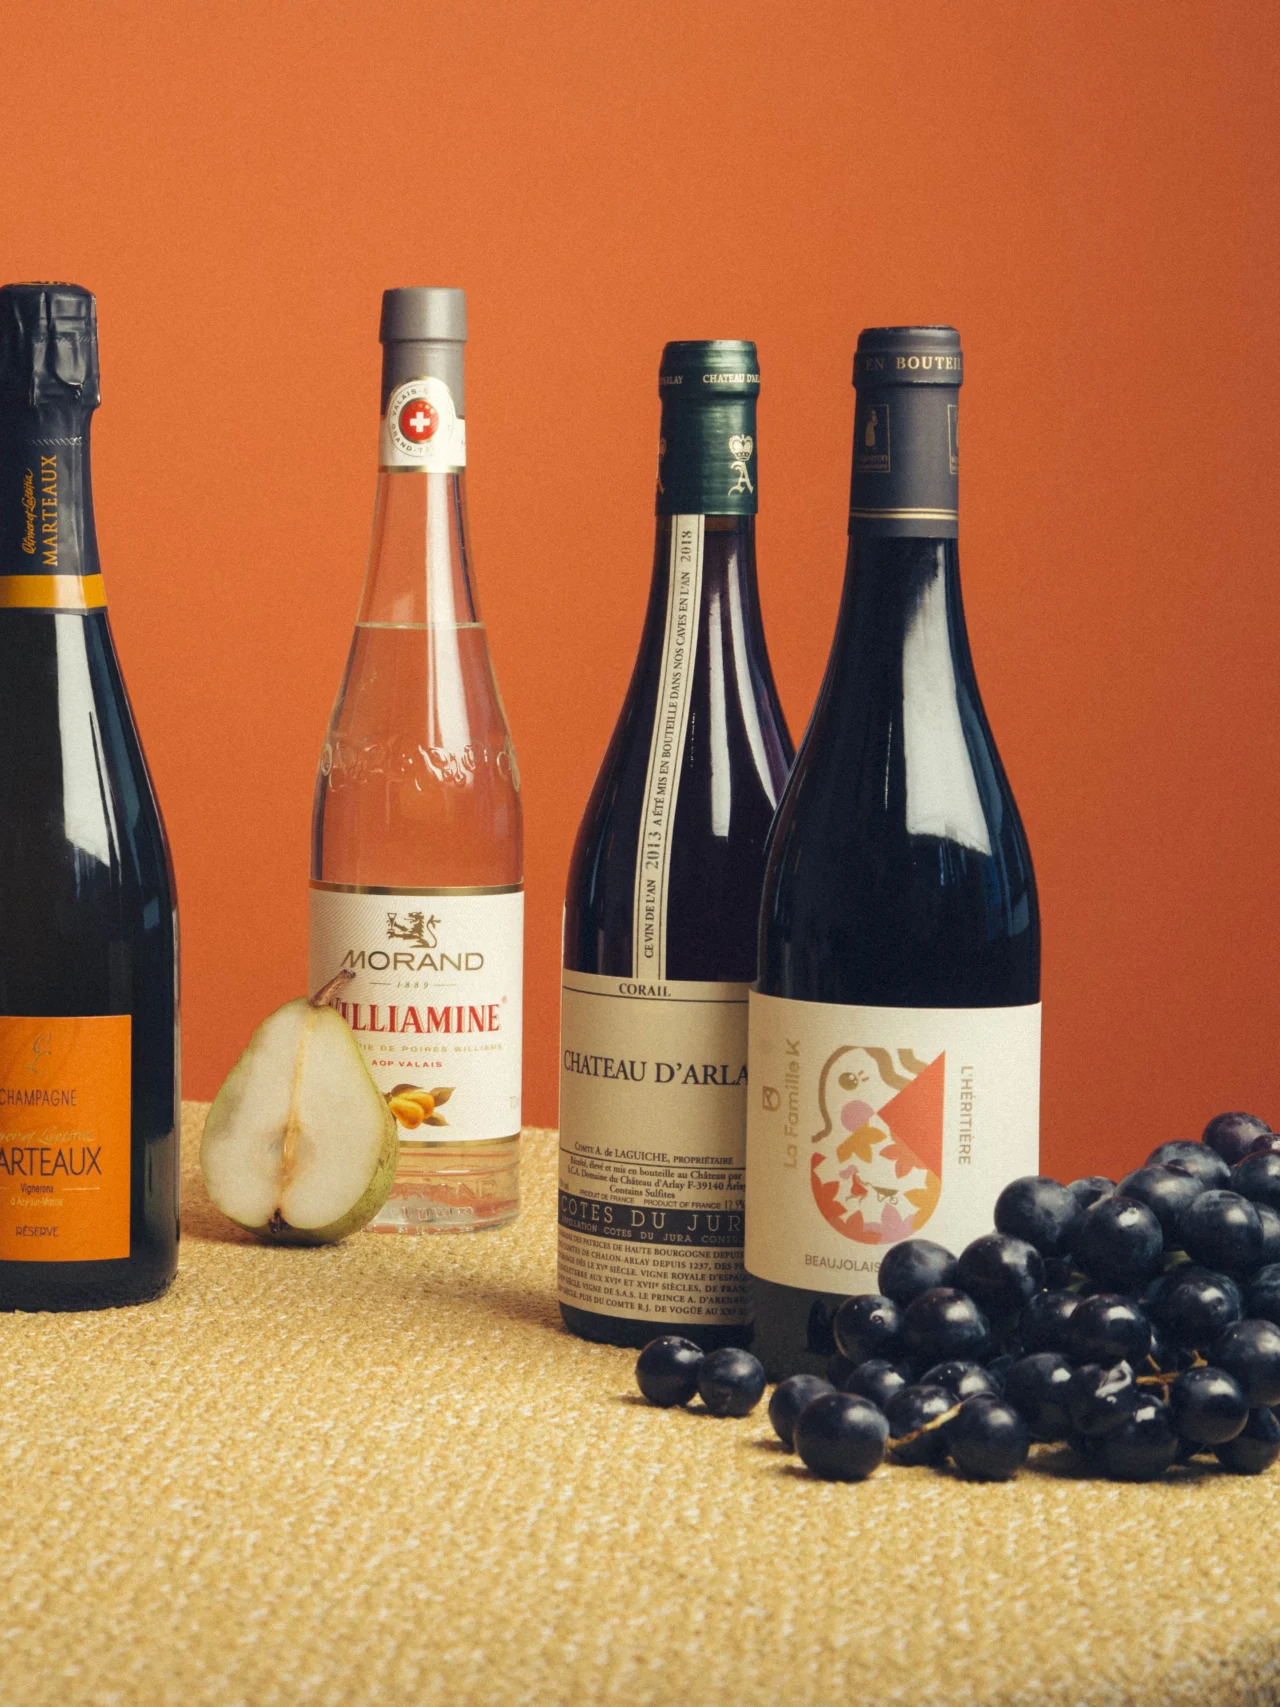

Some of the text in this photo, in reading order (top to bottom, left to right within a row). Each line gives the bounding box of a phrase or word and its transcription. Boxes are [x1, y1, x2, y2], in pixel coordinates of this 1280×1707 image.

[702, 373, 744, 383] CHATEAU
[392, 388, 417, 417] VALAIS
[391, 423, 413, 452] GRAND
[41, 455, 58, 567] MARTEAUX
[680, 530, 693, 563] 2018
[679, 598, 689, 613] EN
[675, 613, 688, 647] CAVES
[673, 647, 685, 670] NOS
[669, 671, 682, 701] DANS
[661, 701, 678, 759] BOUTEILLE
[659, 760, 670, 774] EN
[656, 777, 668, 795] MIS
[652, 797, 665, 817] ÉTÉ
[645, 831, 662, 871] 2013
[644, 905, 655, 919] DE
[644, 920, 655, 942] VIN
[340, 950, 485, 972] MORAND
[644, 944, 654, 959] CE
[397, 981, 429, 989] 1889
[618, 982, 671, 997] CORAIL
[329, 997, 501, 1034] ILLIAMINE
[402, 1045, 448, 1053] POIRES
[454, 1043, 503, 1053] WILLIAMS
[371, 1059, 443, 1068] AOP VALAIS
[564, 1050, 748, 1086] CHATEAU D'ARLA
[783, 1037, 801, 1170] La Famille K
[604, 1147, 613, 1157] de
[615, 1148, 671, 1164] LAGUICHE,
[673, 1155, 734, 1165] PROPRIÉTAIRE
[581, 1168, 608, 1181] Domaine
[609, 1174, 618, 1183] du
[620, 1175, 652, 1187] Château
[687, 1180, 724, 1190] F-39140
[613, 1164, 626, 1174] mis
[639, 1167, 675, 1178] bouteille
[690, 1170, 726, 1180] Château
[728, 1173, 742, 1182] par
[601, 1192, 609, 1200] DE
[610, 1194, 635, 1204] FRANCE
[609, 1184, 676, 1199] Contains Sulfites
[560, 1195, 741, 1232] COTES DU JUR
[644, 1198, 678, 1207] PRODUCT
[691, 1201, 721, 1209] FRANCE
[15, 1225, 60, 1237] RÉSERVE
[603, 1226, 632, 1238] COTES
[640, 1231, 654, 1240] DU
[663, 1233, 693, 1243] JURA
[581, 1249, 590, 1257] DE
[652, 1259, 686, 1269] DEPUIS
[714, 1262, 732, 1270] DES
[612, 1243, 623, 1252] DE
[624, 1244, 653, 1255] HAUTE
[654, 1248, 711, 1259] BOURGOGNE
[804, 1254, 881, 1273] BEAUJOLAIS
[589, 1272, 603, 1282] AUX
[623, 1278, 634, 1287] ET
[705, 1285, 718, 1293] DE
[640, 1269, 668, 1279] VIGNE
[671, 1272, 705, 1281] ROYALE
[582, 1281, 602, 1293] VIGNE
[603, 1287, 614, 1295] DE
[638, 1291, 649, 1300] LE
[651, 1293, 685, 1303] PRINCE
[687, 1296, 696, 1304] A.
[579, 1292, 592, 1302] PUIS
[593, 1296, 605, 1305] DU
[605, 1298, 636, 1310] COMTE
[654, 1304, 667, 1313] DE
[705, 1308, 718, 1316] AU
